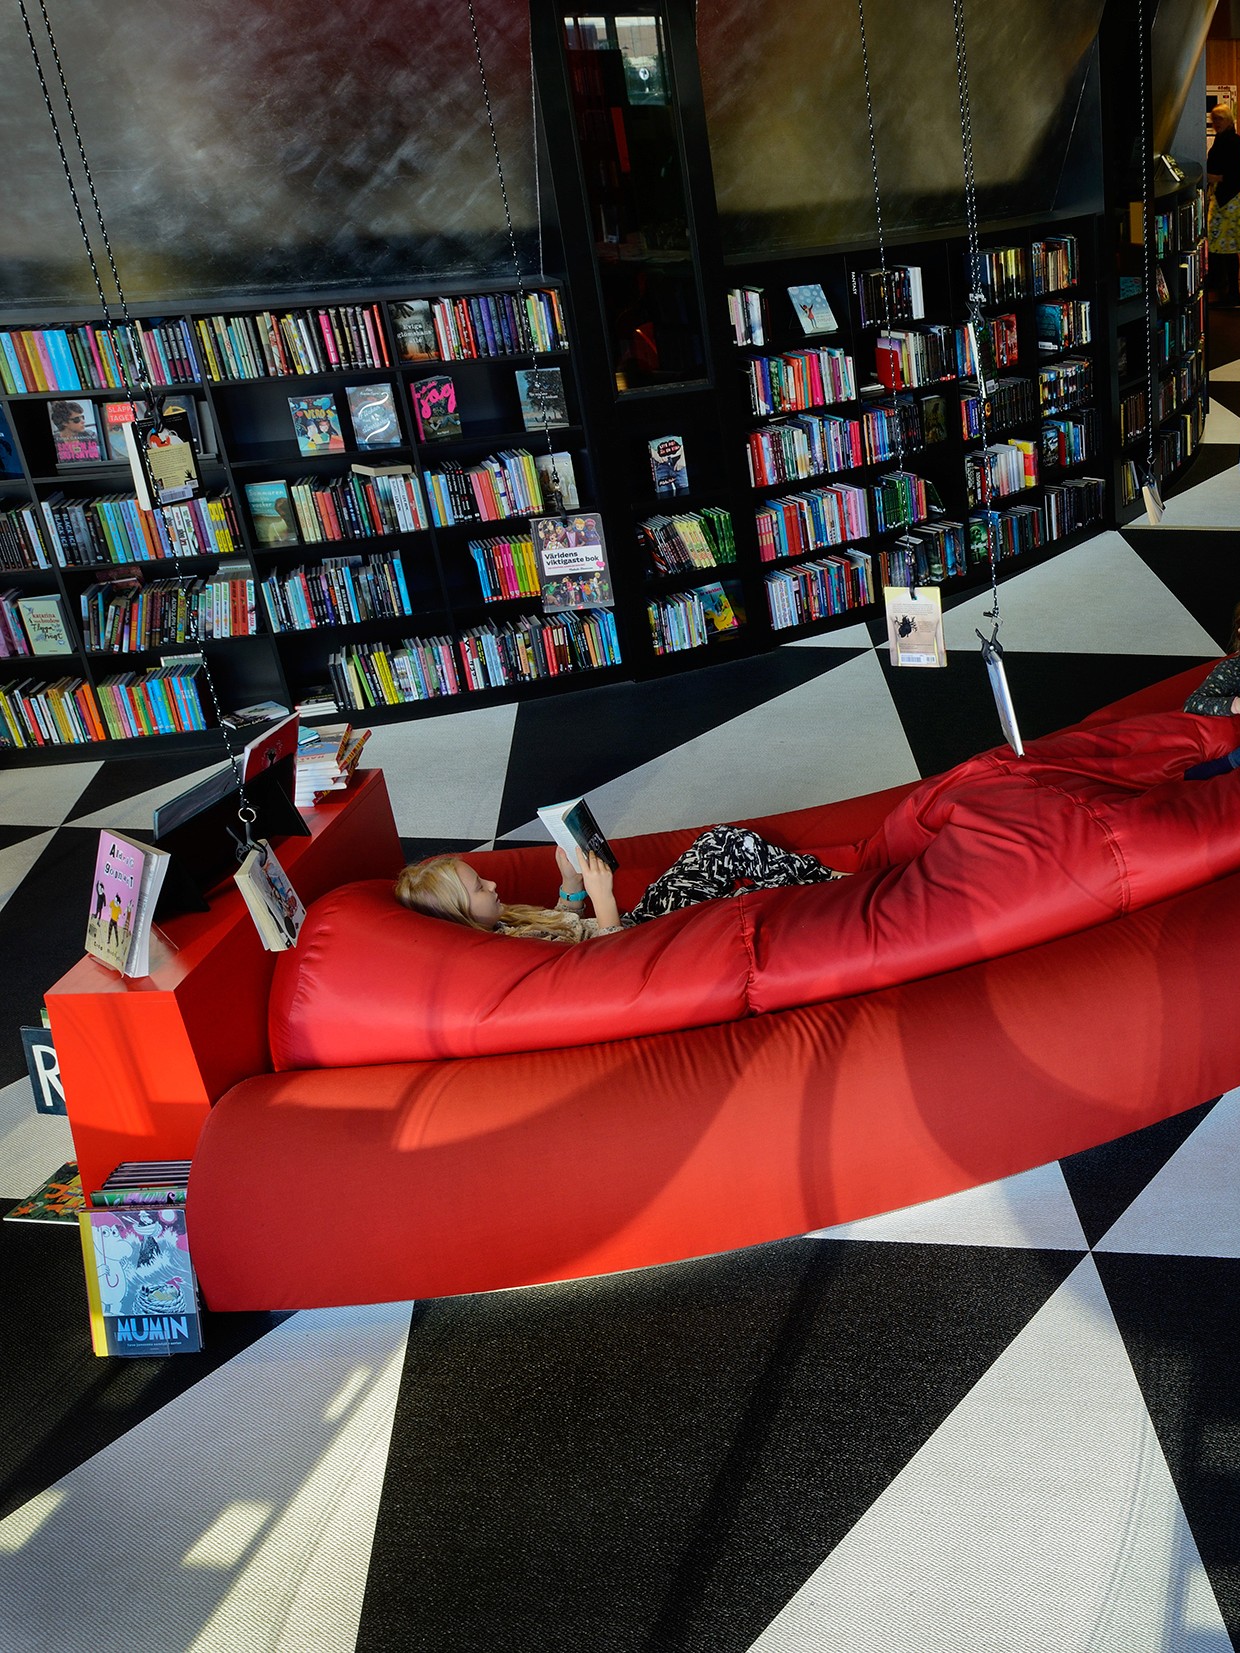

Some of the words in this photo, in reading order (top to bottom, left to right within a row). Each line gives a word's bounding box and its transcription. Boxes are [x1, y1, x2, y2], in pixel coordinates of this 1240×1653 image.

[108, 404, 134, 413] SLÄPP
[62, 513, 73, 534] BLACK
[545, 552, 578, 560] Världens
[546, 557, 584, 566] viktigaste
[117, 1316, 189, 1342] MUMIN
